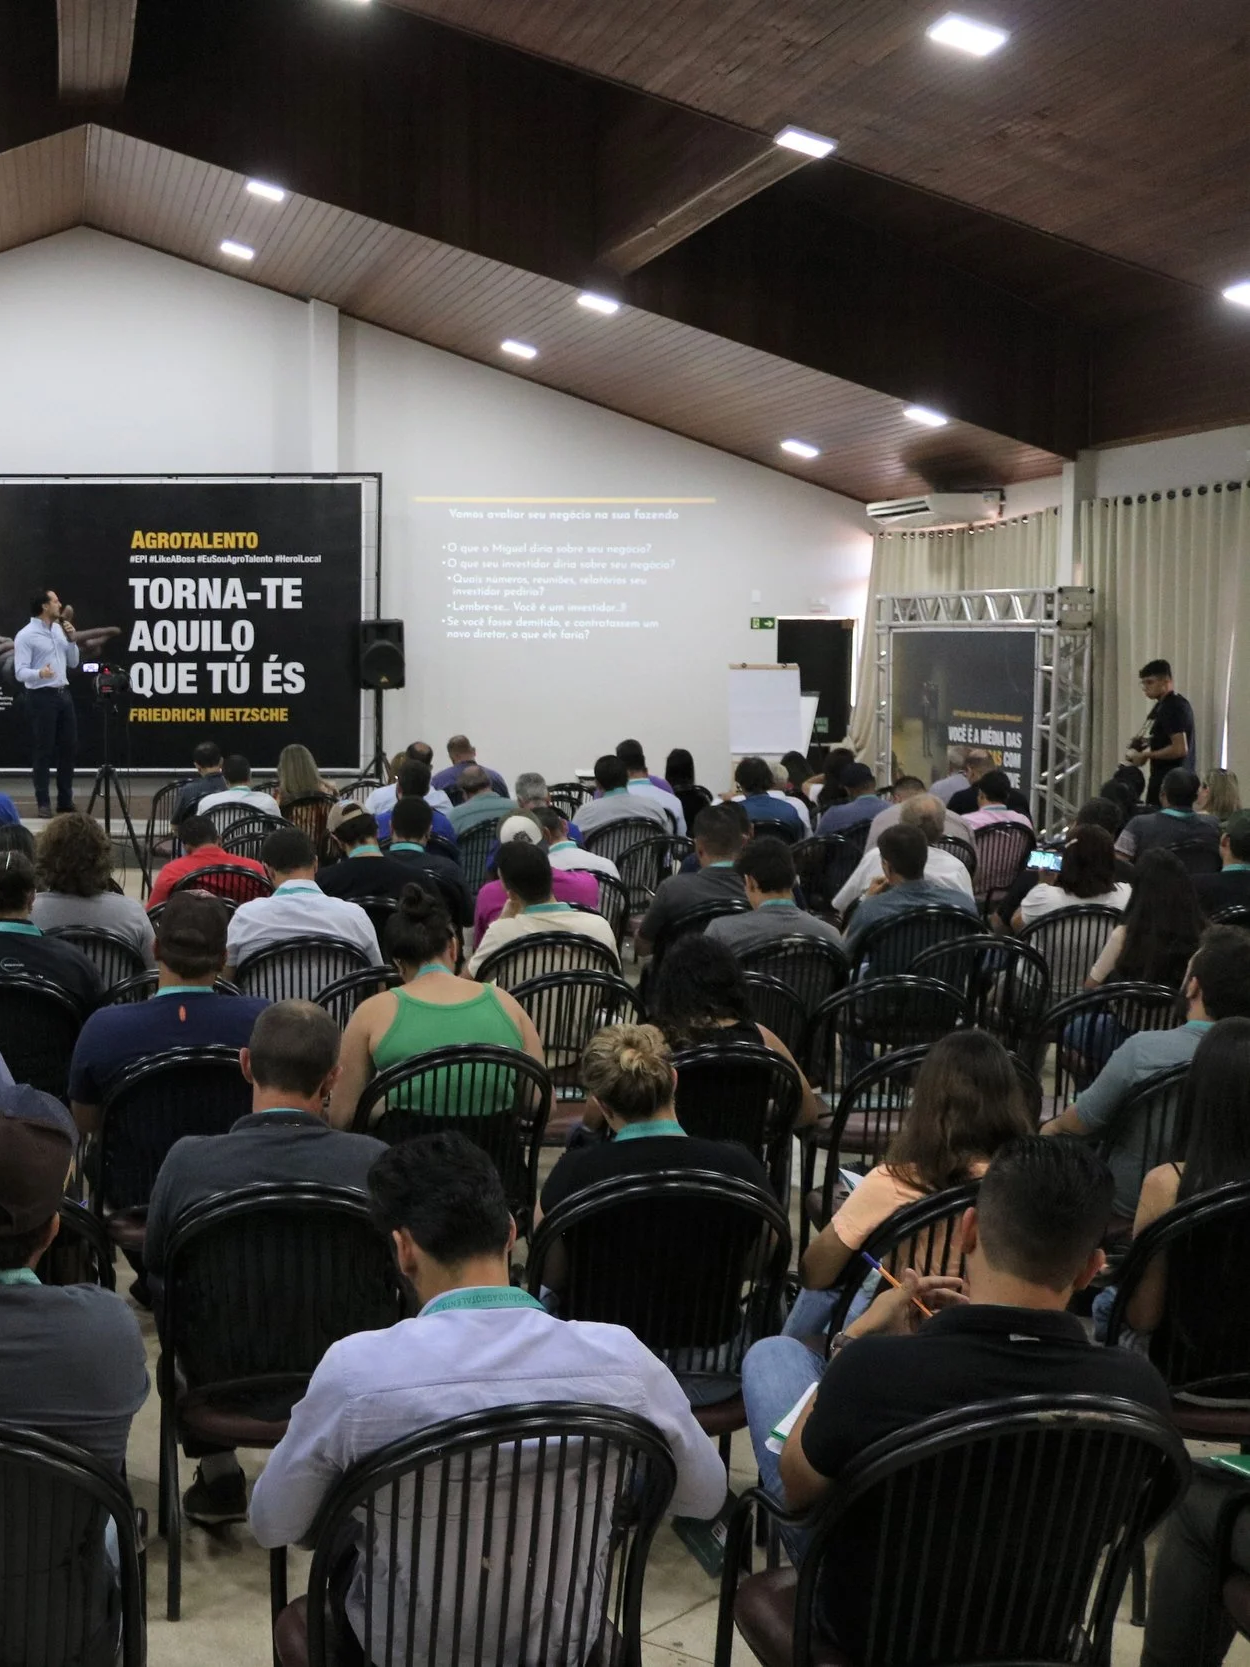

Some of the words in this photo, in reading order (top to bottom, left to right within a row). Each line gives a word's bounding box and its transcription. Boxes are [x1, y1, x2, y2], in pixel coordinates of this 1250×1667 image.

[449, 509, 484, 519] Vamos
[486, 509, 524, 519] avaliar
[634, 509, 679, 519] fazenda
[130, 530, 259, 549] AGROTALENTO
[130, 554, 148, 563] #EPI
[149, 554, 196, 563] #LikeABoss
[196, 554, 273, 564] #EuSouAgroTalento
[274, 554, 322, 563] #HeroiLocal
[128, 578, 302, 610] TORNA-TE
[128, 620, 255, 656] AQUILO
[129, 662, 198, 698] QUE
[206, 654, 250, 694] TÚ
[262, 654, 306, 694] ÉS
[129, 708, 206, 722] FRIEDRICH
[210, 708, 288, 722] NIETZSCHE
[948, 724, 967, 742] VOCÊ
[968, 724, 973, 744] É
[974, 728, 979, 744] A
[980, 726, 1004, 746] MÉDIA
[1005, 731, 1022, 749] DAS
[1003, 751, 1021, 769] COM
